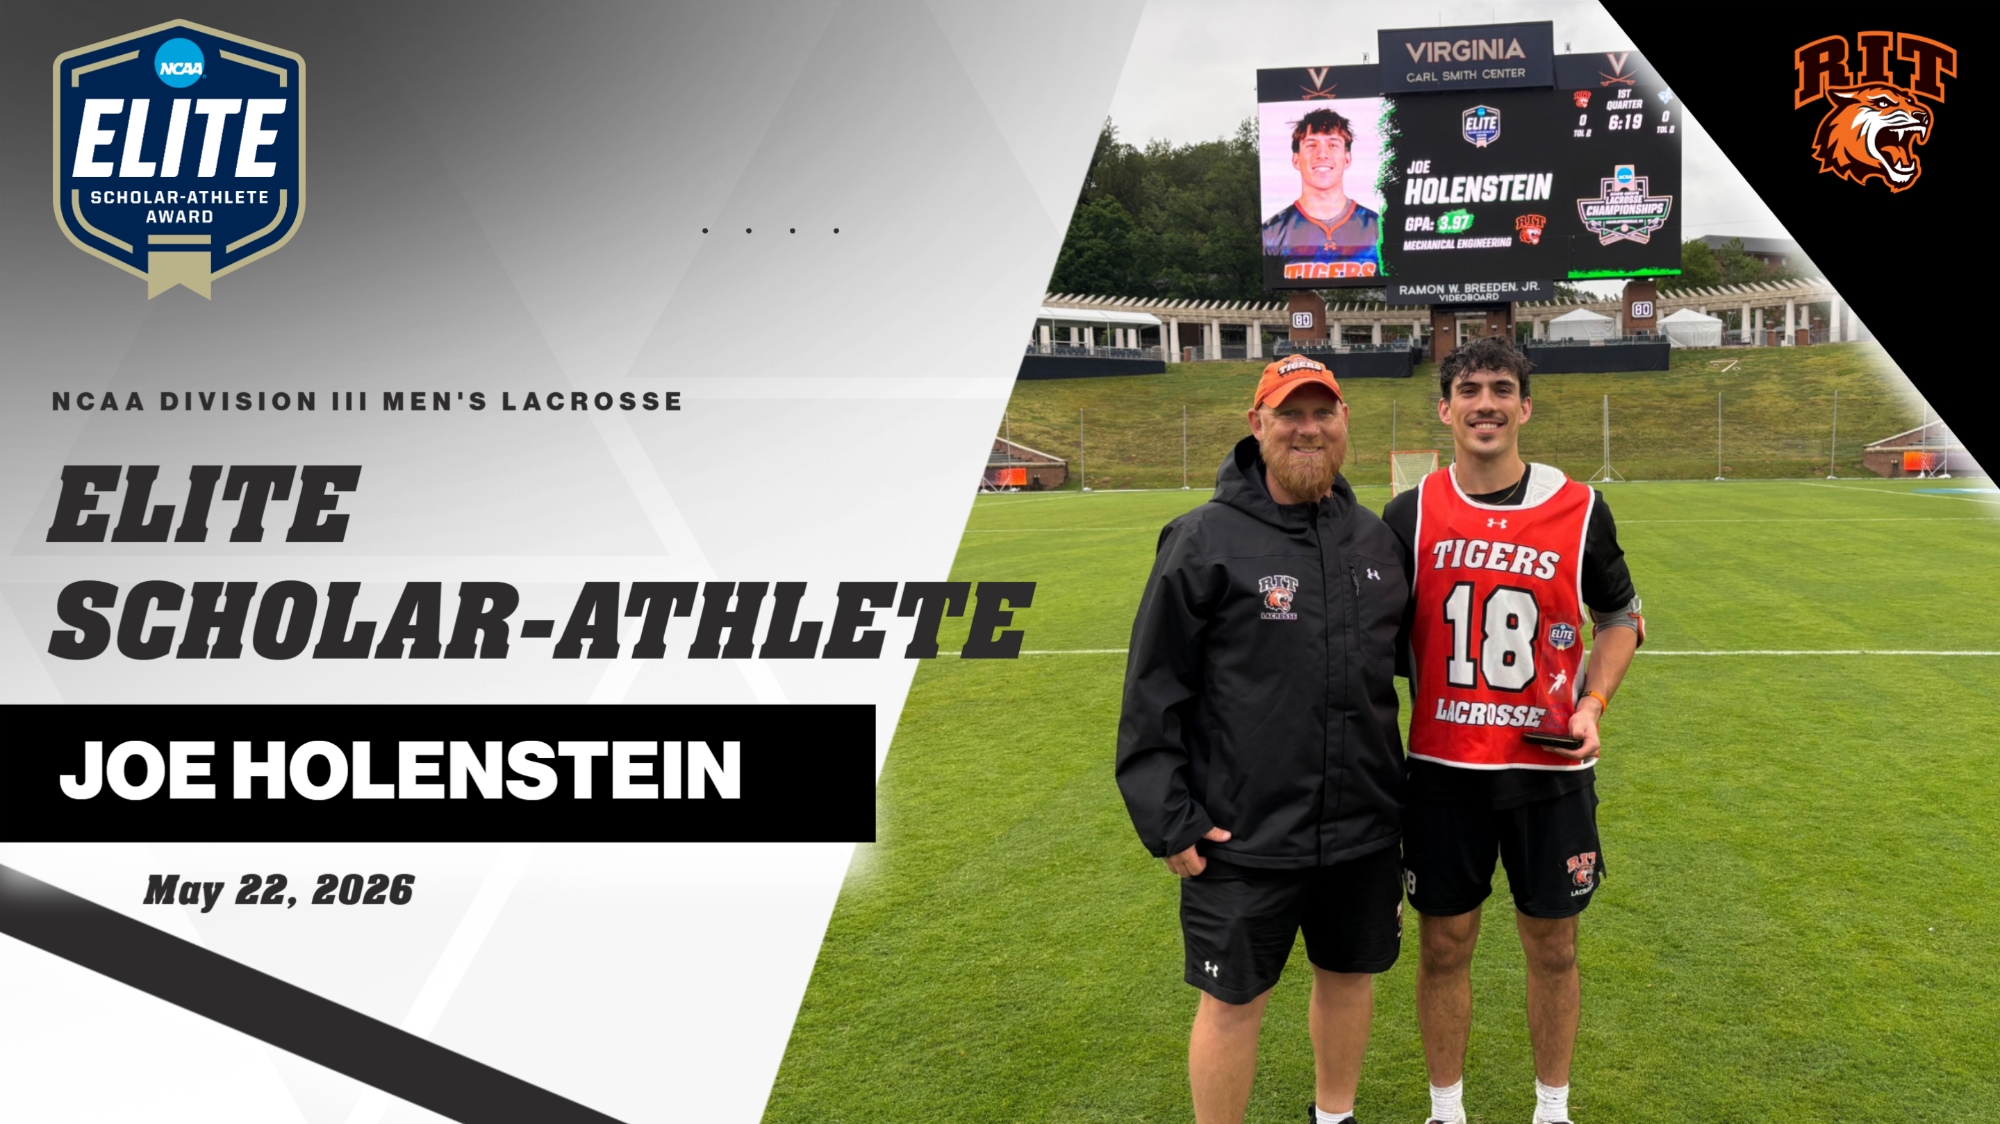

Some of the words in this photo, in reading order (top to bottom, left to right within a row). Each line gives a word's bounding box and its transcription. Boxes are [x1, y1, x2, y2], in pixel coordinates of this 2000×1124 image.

[1405, 37, 1526, 64] VIRGINIA
[1406, 72, 1438, 83] CARL
[1442, 69, 1478, 81] SMITH
[1481, 67, 1526, 79] CENTER
[1617, 88, 1632, 99] 1ST
[1606, 99, 1643, 111] QUARTER
[1465, 116, 1498, 131] ELITE
[1579, 114, 1588, 126] 0
[1608, 113, 1643, 131] 6:19
[1661, 110, 1670, 123] 0
[1406, 159, 1431, 175] JOE
[1404, 172, 1554, 206] HOLENSTEIN
[1605, 194, 1643, 205] LACROSSE
[1586, 202, 1665, 217] CHAMPIONSHIPS
[1404, 216, 1435, 232] GPA:
[1438, 214, 1470, 231] 3.97
[1515, 214, 1547, 231] RIT
[1403, 238, 1456, 251] MECHANICAL
[1456, 236, 1512, 249] ENGINEERING
[1399, 284, 1445, 295] RAMON
[1448, 283, 1460, 294] W.
[1521, 280, 1541, 292] JR.
[1439, 293, 1499, 302] VIDEOBOARD
[1634, 303, 1651, 316] 80
[1295, 314, 1311, 327] 80
[1278, 361, 1323, 376] TIGERS
[1433, 538, 1561, 581] TIGERS
[1259, 575, 1298, 593] RIT
[1260, 612, 1298, 620] LACROSSE
[1443, 581, 1540, 693] 18
[1551, 628, 1574, 640] ELITE
[1435, 697, 1548, 729] LACROSSE
